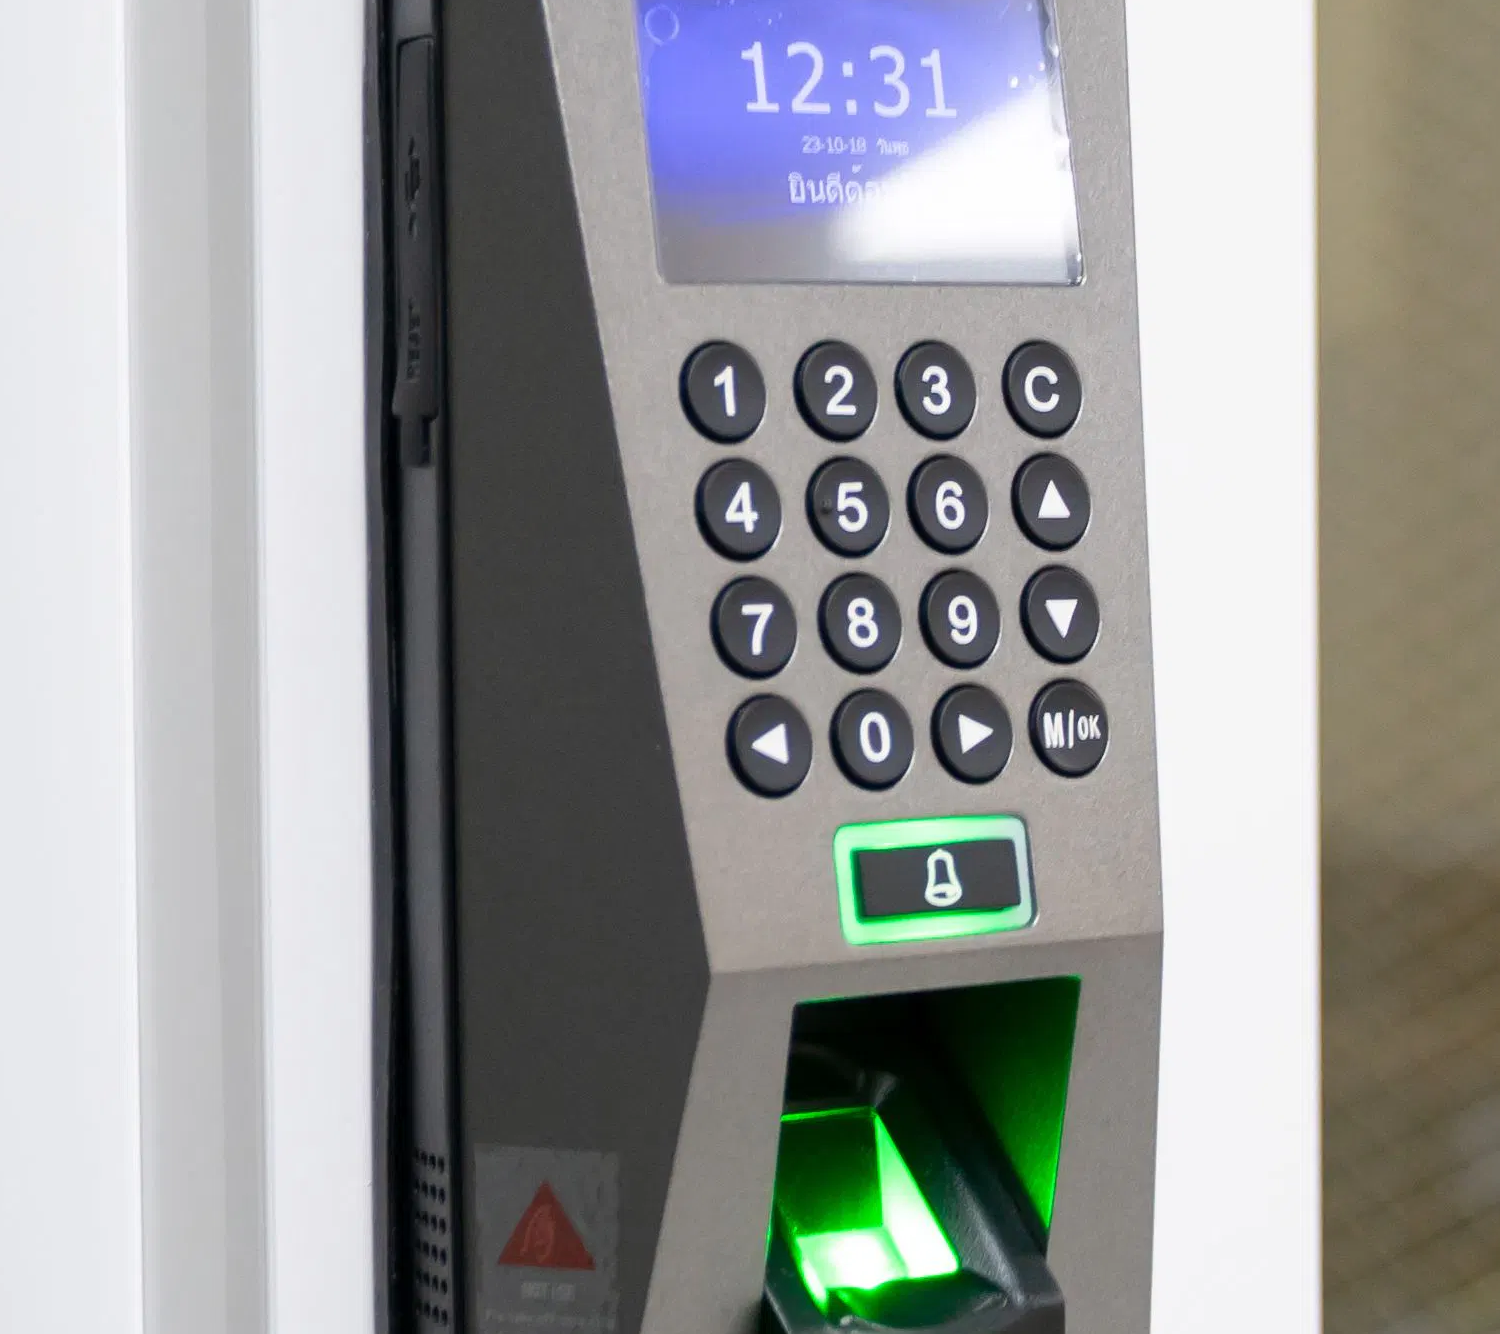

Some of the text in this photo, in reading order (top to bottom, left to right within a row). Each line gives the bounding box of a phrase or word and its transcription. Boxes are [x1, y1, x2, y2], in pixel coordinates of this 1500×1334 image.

[740, 40, 958, 118] 12:31
[713, 364, 1060, 417] 1 2 3 C
[724, 480, 966, 533] 4 5 6
[741, 595, 978, 656] 7 8 9
[859, 711, 891, 763] 0
